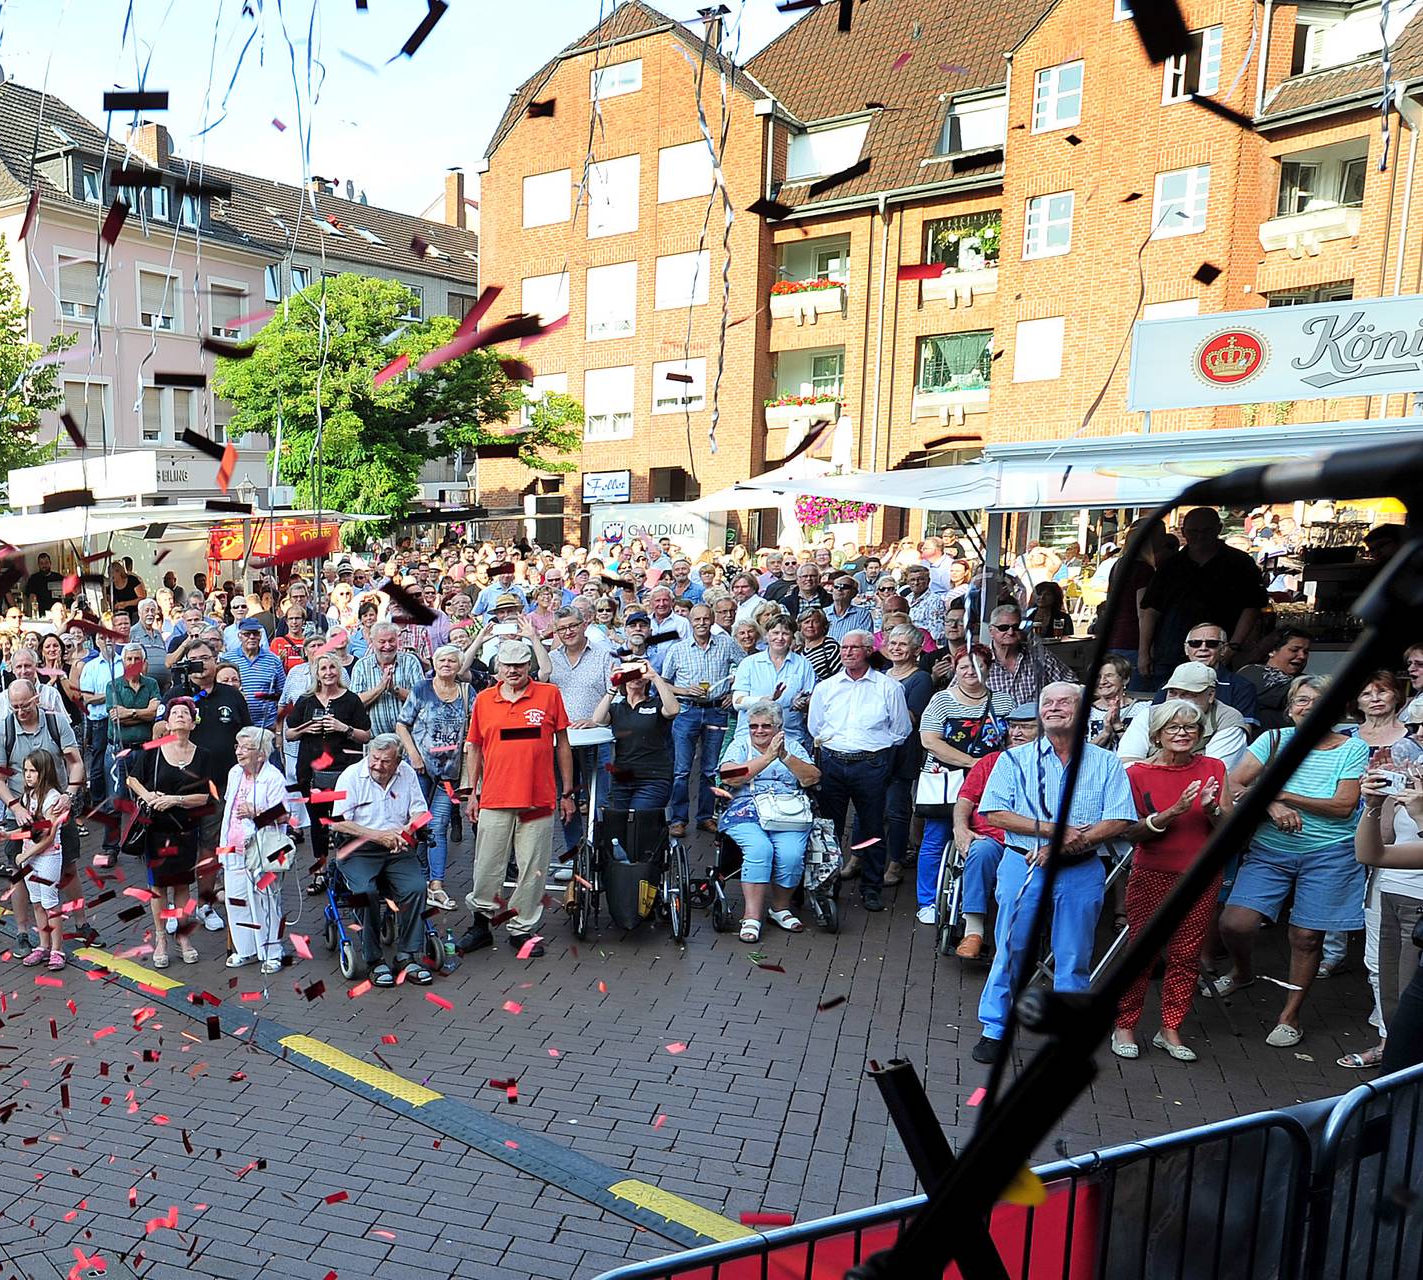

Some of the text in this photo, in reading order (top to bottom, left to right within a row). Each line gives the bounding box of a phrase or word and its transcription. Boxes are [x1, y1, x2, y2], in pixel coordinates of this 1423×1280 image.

[1291, 311, 1423, 374] Köni
[161, 469, 189, 482] EILING
[628, 523, 695, 536] GAUDIUM
